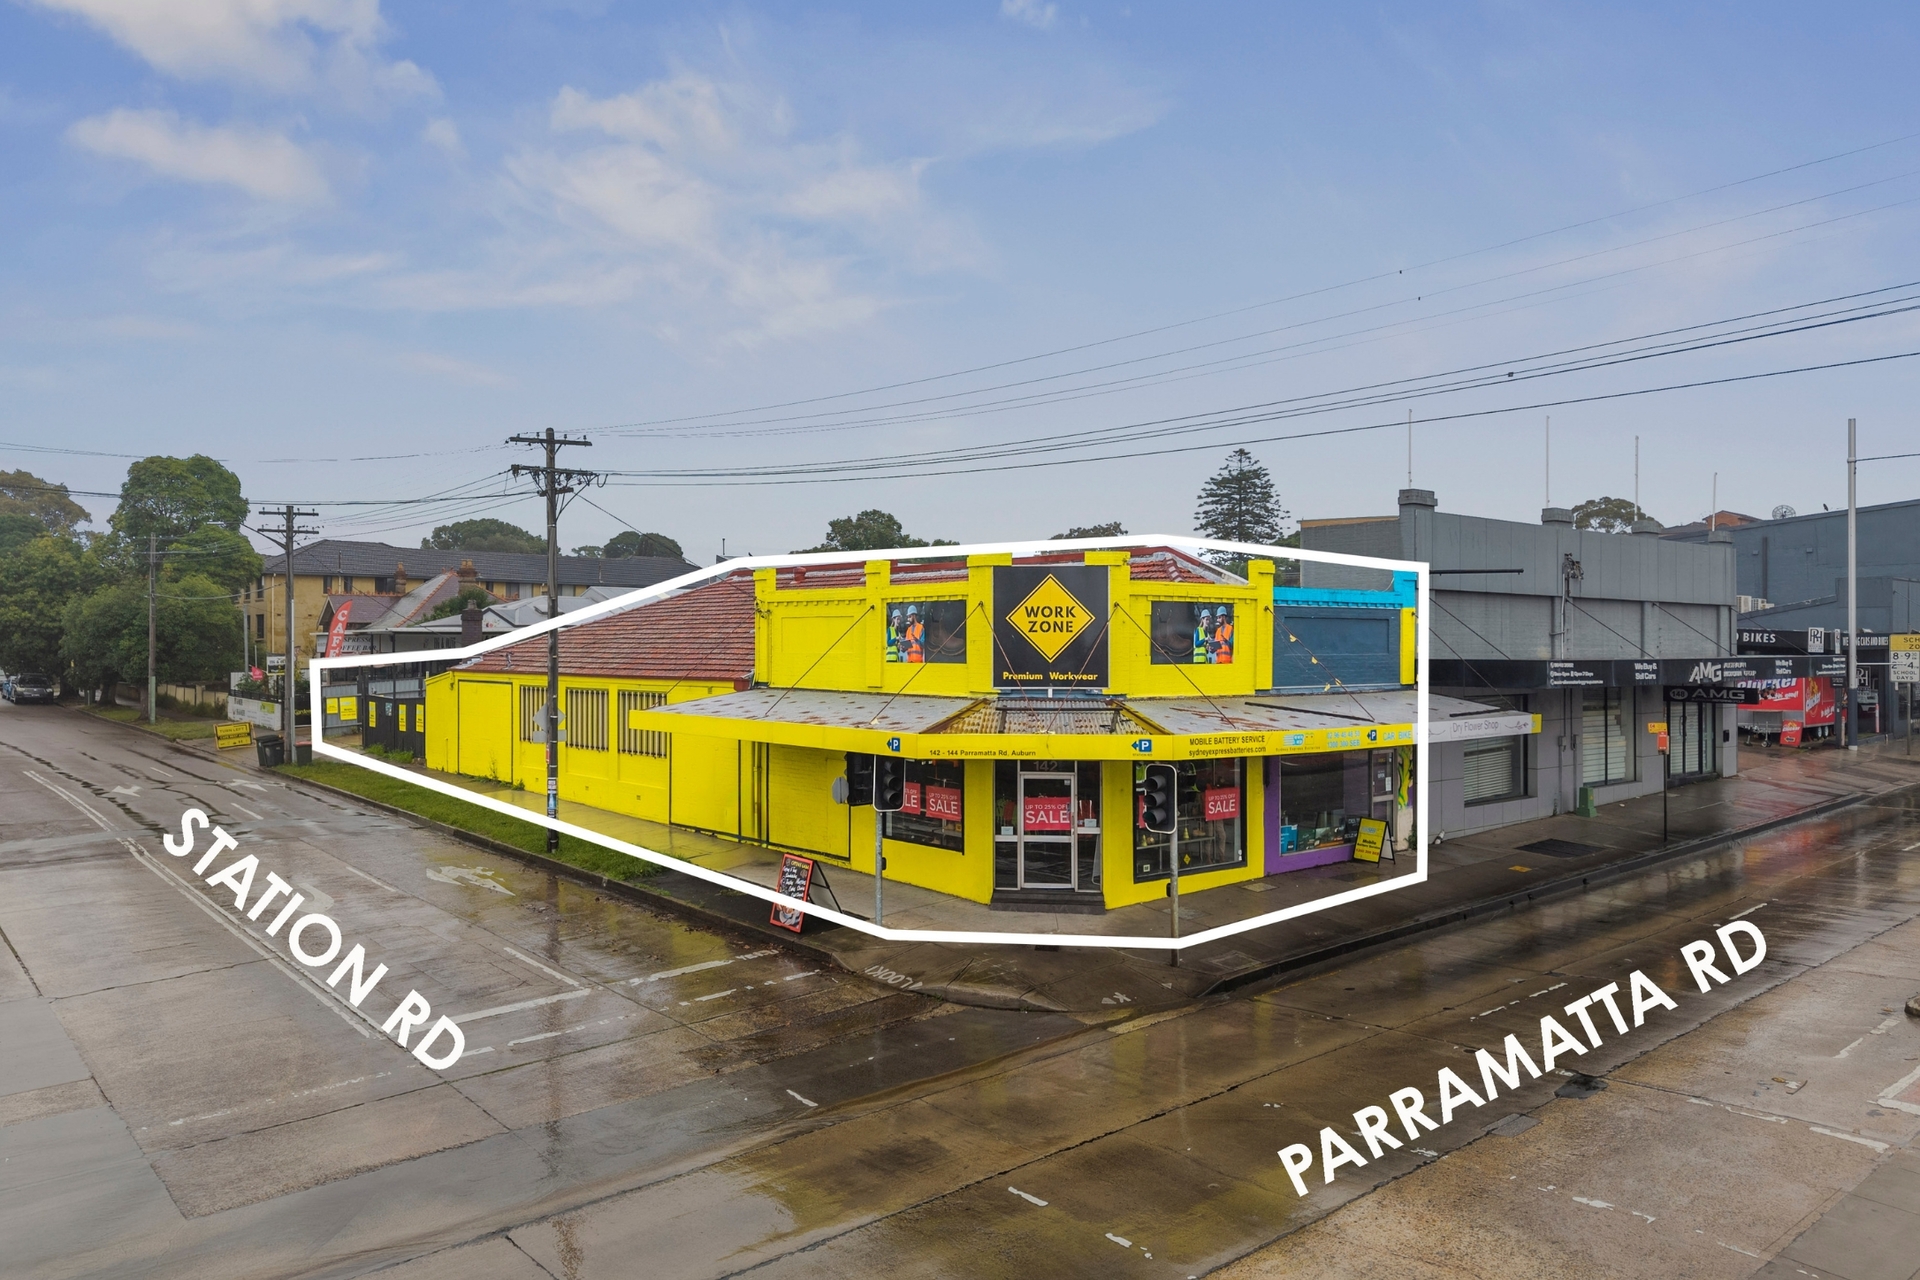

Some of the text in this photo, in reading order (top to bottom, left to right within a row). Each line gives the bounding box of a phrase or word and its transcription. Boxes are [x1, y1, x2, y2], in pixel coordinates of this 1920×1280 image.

[1025, 605, 1077, 618] WORK
[1028, 621, 1073, 633] ZONE
[1743, 633, 1776, 643] BIKES
[1893, 652, 1899, 660] 8
[1905, 652, 1911, 660] 9
[1003, 671, 1098, 680] Premium Workwear
[1689, 662, 1722, 684] AMG
[1672, 690, 1686, 698] 148
[1452, 720, 1500, 734] Dry Flower Shop
[1189, 735, 1266, 746] MOBILE BATTERY SERVICE
[1383, 730, 1412, 741] CAR BIKE
[892, 739, 899, 749] P
[1141, 741, 1149, 751] P
[960, 749, 996, 757] Parramatta
[1188, 746, 1267, 757] sydneyexpressbatteries.com
[1033, 760, 1058, 772] 142
[905, 796, 918, 808] LE
[929, 799, 959, 815] SALE
[1208, 799, 1236, 815] SALE
[1025, 810, 1070, 824] SALE
